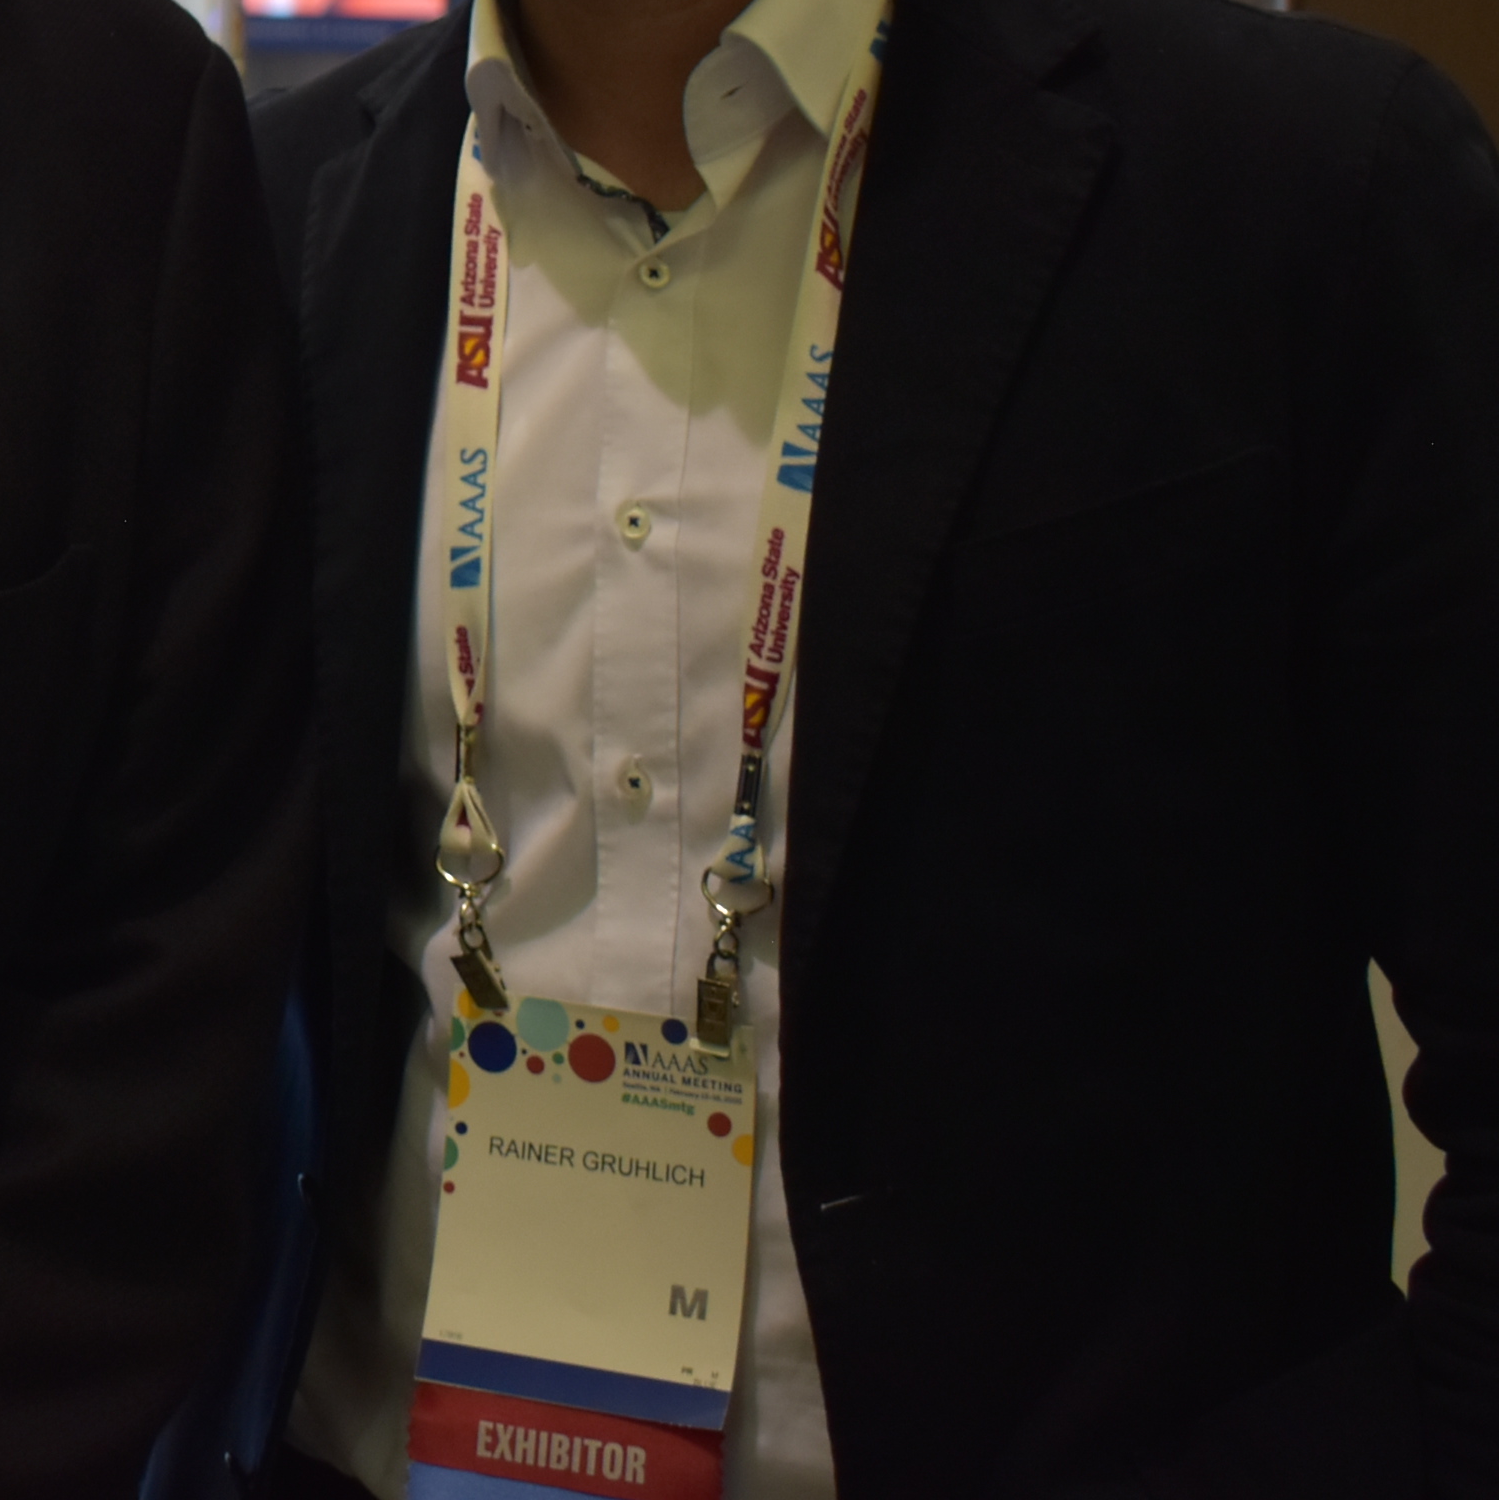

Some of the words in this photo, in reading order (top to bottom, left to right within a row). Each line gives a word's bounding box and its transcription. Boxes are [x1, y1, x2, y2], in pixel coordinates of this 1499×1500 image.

[464, 192, 484, 237] State
[459, 237, 481, 308] Arizona
[477, 224, 503, 309] University
[455, 310, 494, 390] ASU
[457, 446, 489, 543] AAAS
[748, 581, 774, 661] Arizona
[762, 526, 786, 581] State
[765, 565, 801, 665] University
[623, 1067, 677, 1085] ANNUAL
[681, 1075, 744, 1095] MEETING
[651, 1051, 710, 1076] AAAS
[621, 1092, 696, 1117] #AAASmtg
[489, 1135, 575, 1168] RAINER
[581, 1148, 706, 1190] GRUHLICH
[667, 1284, 710, 1322] M
[475, 1419, 647, 1485] EXHIBITOR
